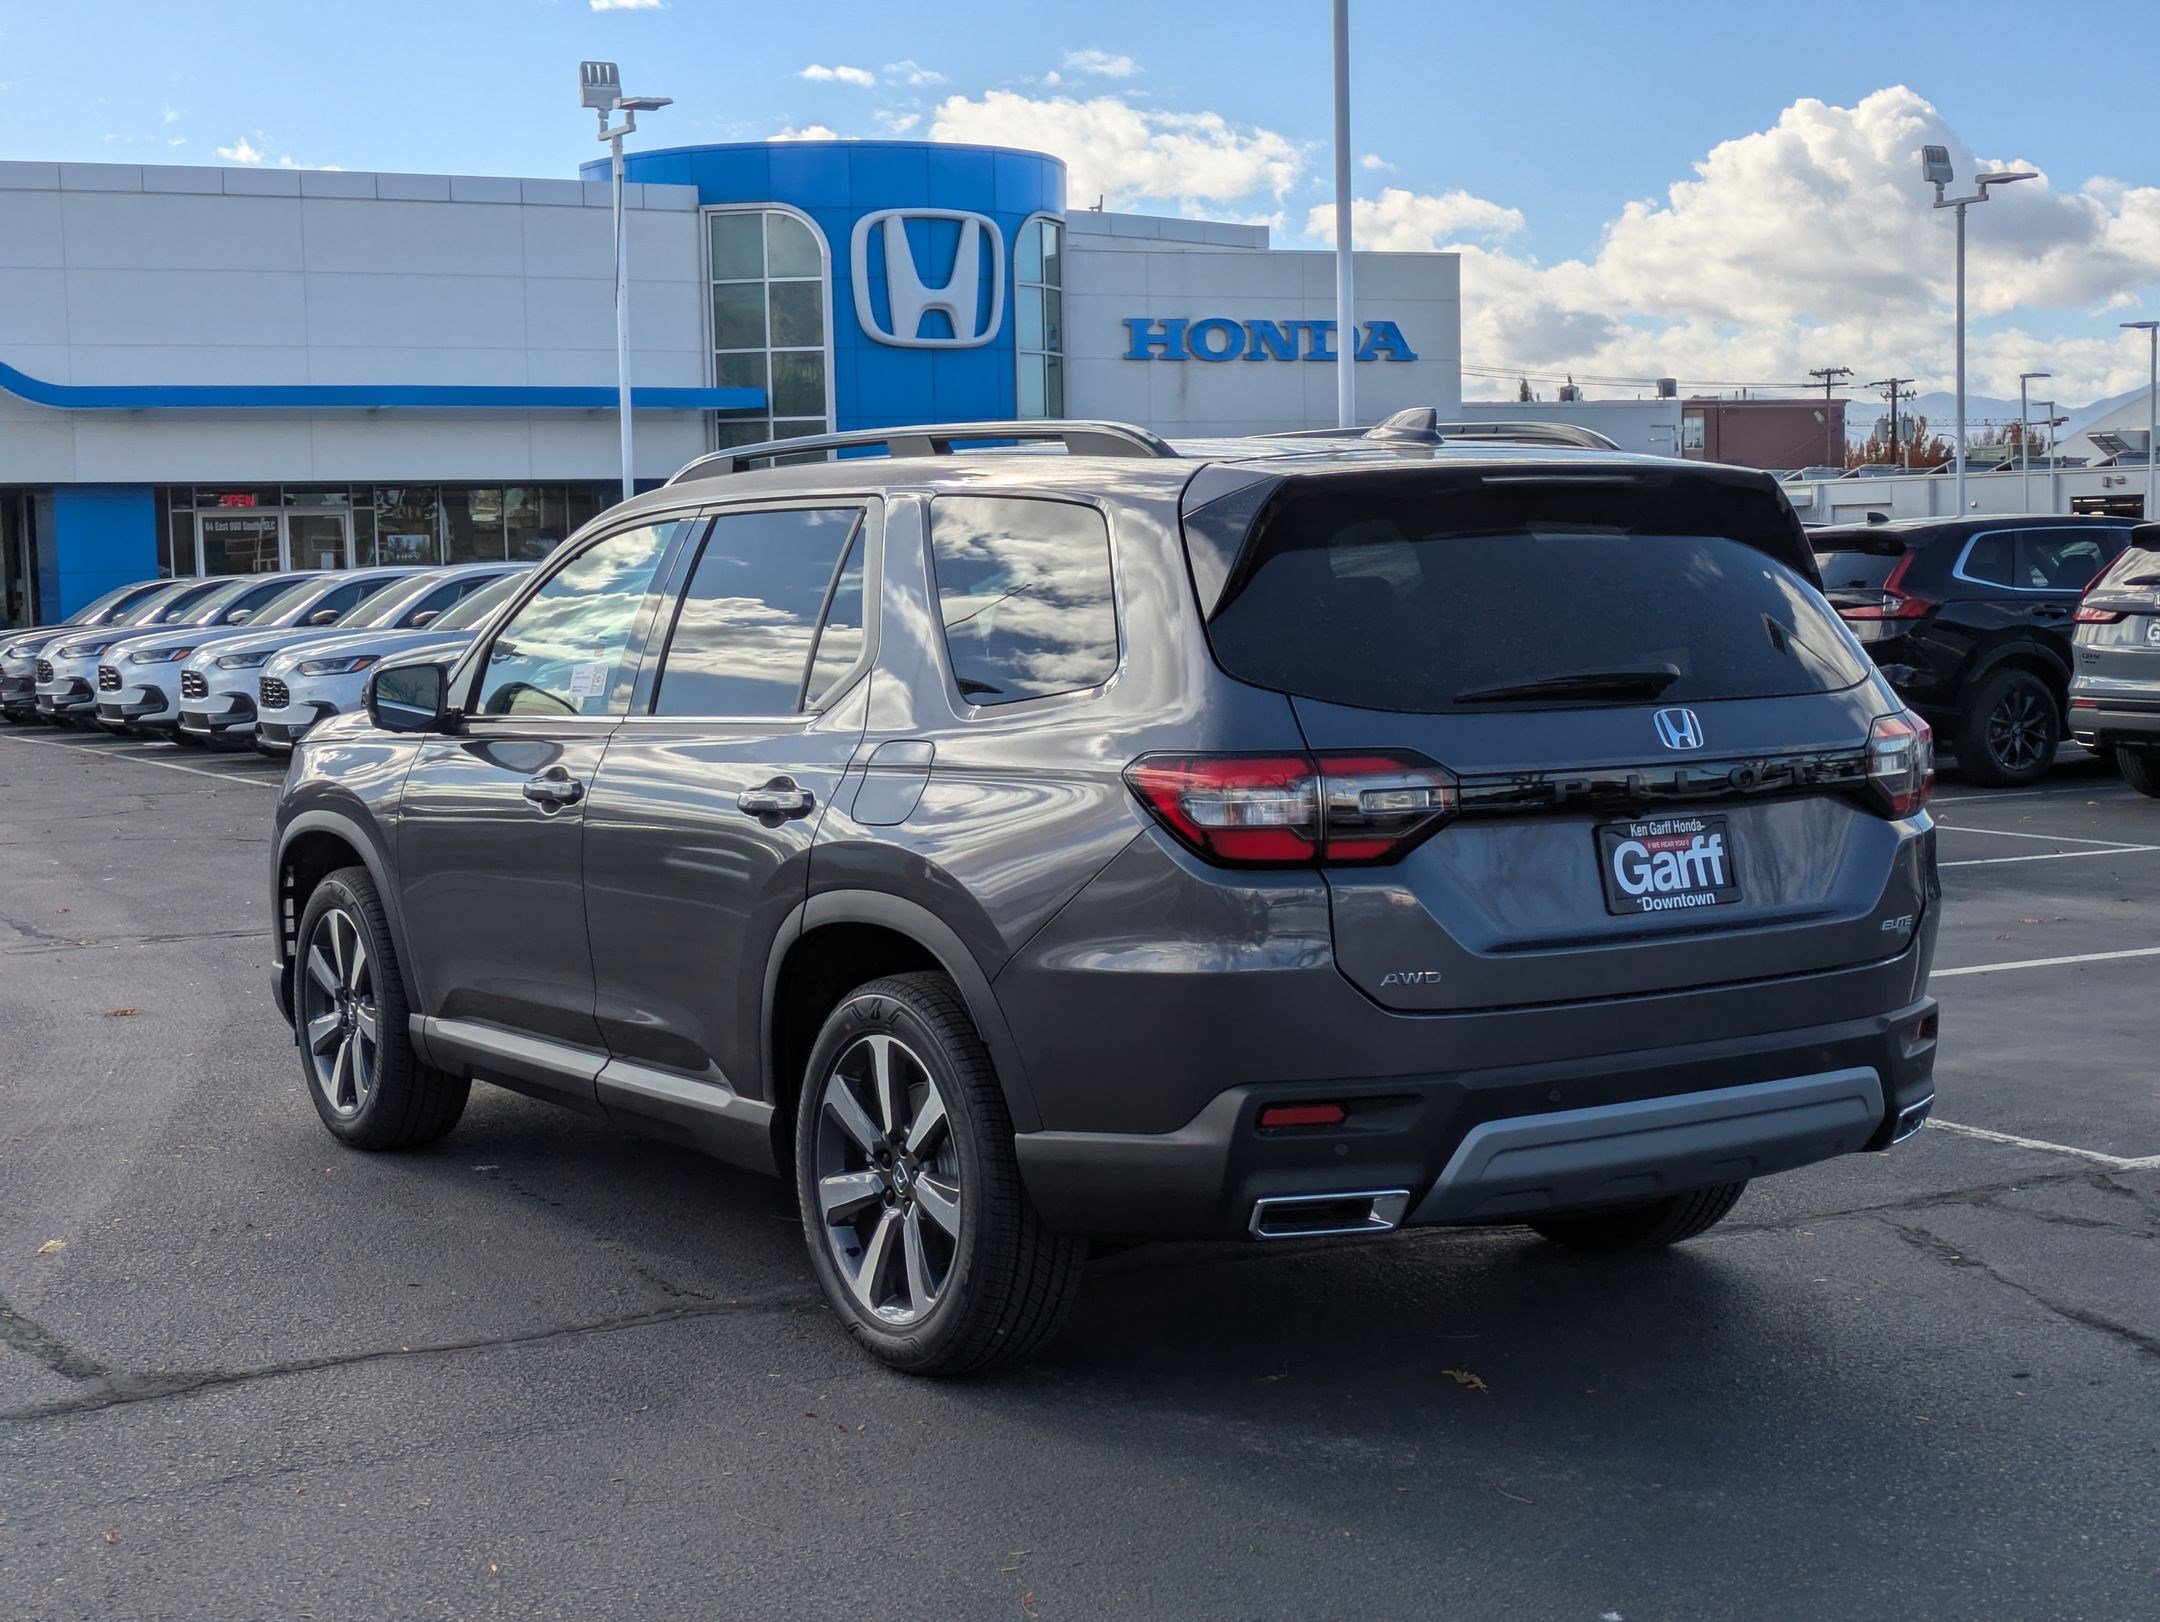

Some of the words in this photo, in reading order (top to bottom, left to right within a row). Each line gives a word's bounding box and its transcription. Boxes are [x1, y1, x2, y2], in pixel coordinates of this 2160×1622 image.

[1122, 317, 1418, 362] HONDA
[215, 521, 228, 531] East
[1630, 823, 1648, 837] Ken
[1650, 821, 1672, 835] Garff
[1673, 819, 1702, 833] Honda
[1660, 840, 1674, 848] HEAR
[1675, 839, 1685, 847] YOU
[1613, 833, 1724, 895] Garff
[1642, 892, 1716, 911] Downtown
[1882, 915, 1912, 931] ELITE
[1380, 972, 1442, 987] AWD
